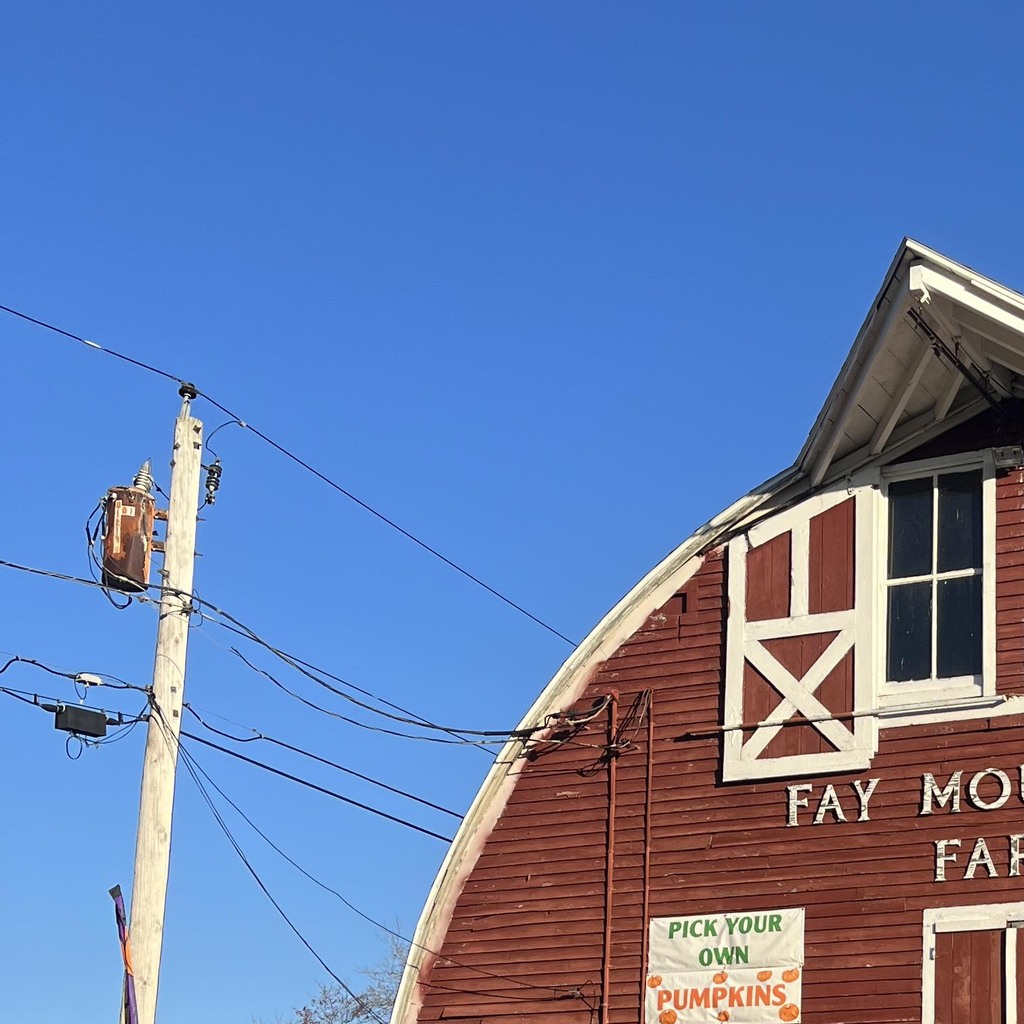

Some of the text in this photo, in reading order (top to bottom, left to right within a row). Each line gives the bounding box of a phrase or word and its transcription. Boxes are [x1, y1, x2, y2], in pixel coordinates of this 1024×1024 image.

[786, 778, 880, 827] FAY
[668, 914, 782, 939] PICK YOUR
[698, 946, 749, 966] OWN
[657, 984, 787, 1011] PUMPKINS
